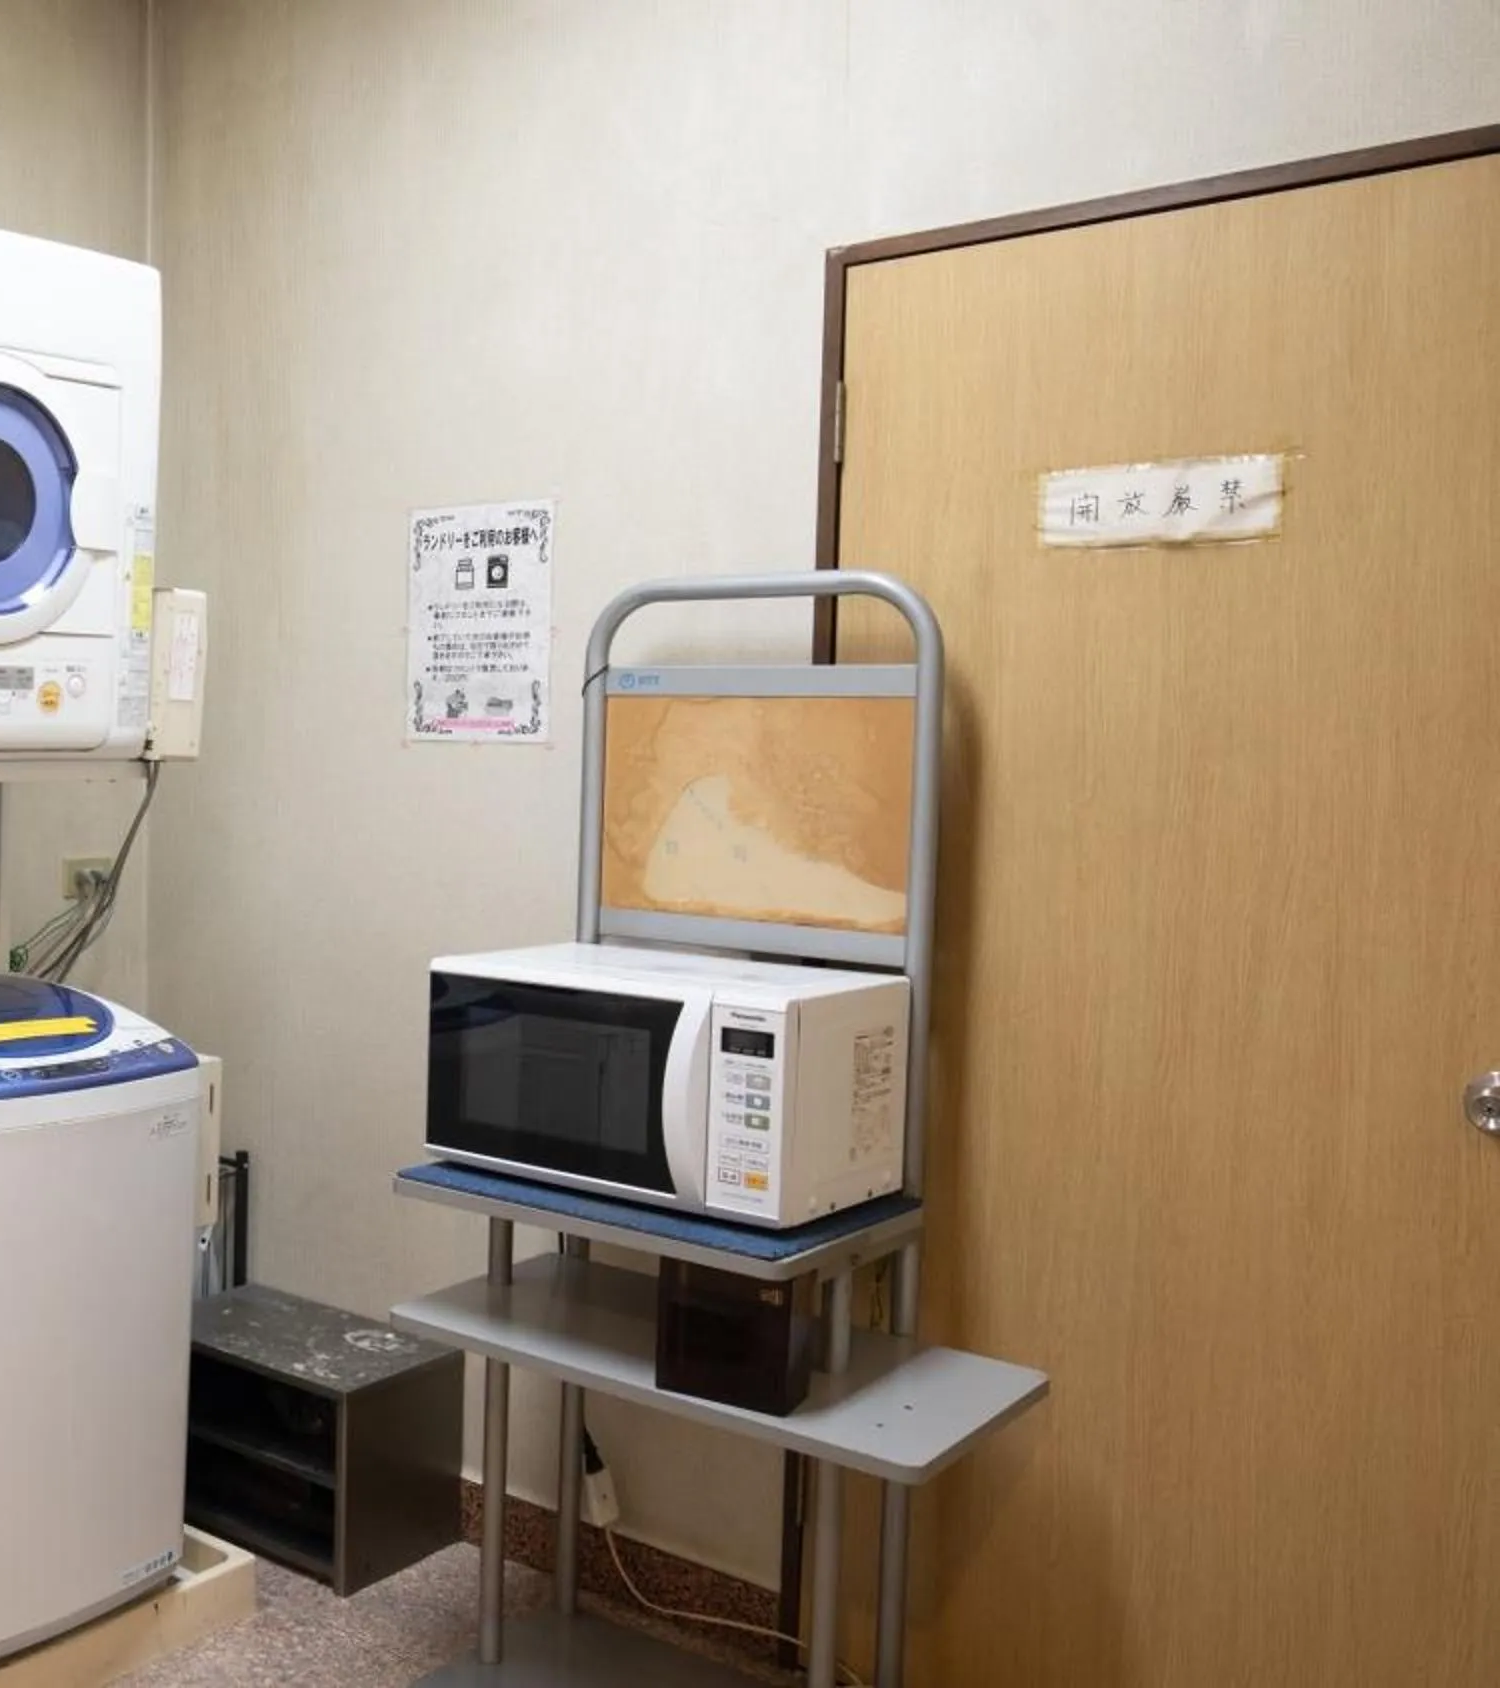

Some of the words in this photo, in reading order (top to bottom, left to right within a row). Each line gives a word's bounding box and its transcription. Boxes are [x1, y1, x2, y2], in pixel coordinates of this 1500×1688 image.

[1070, 479, 1246, 526] 開放厳禁
[423, 527, 539, 552] ランドリーをご利用のお客様へ
